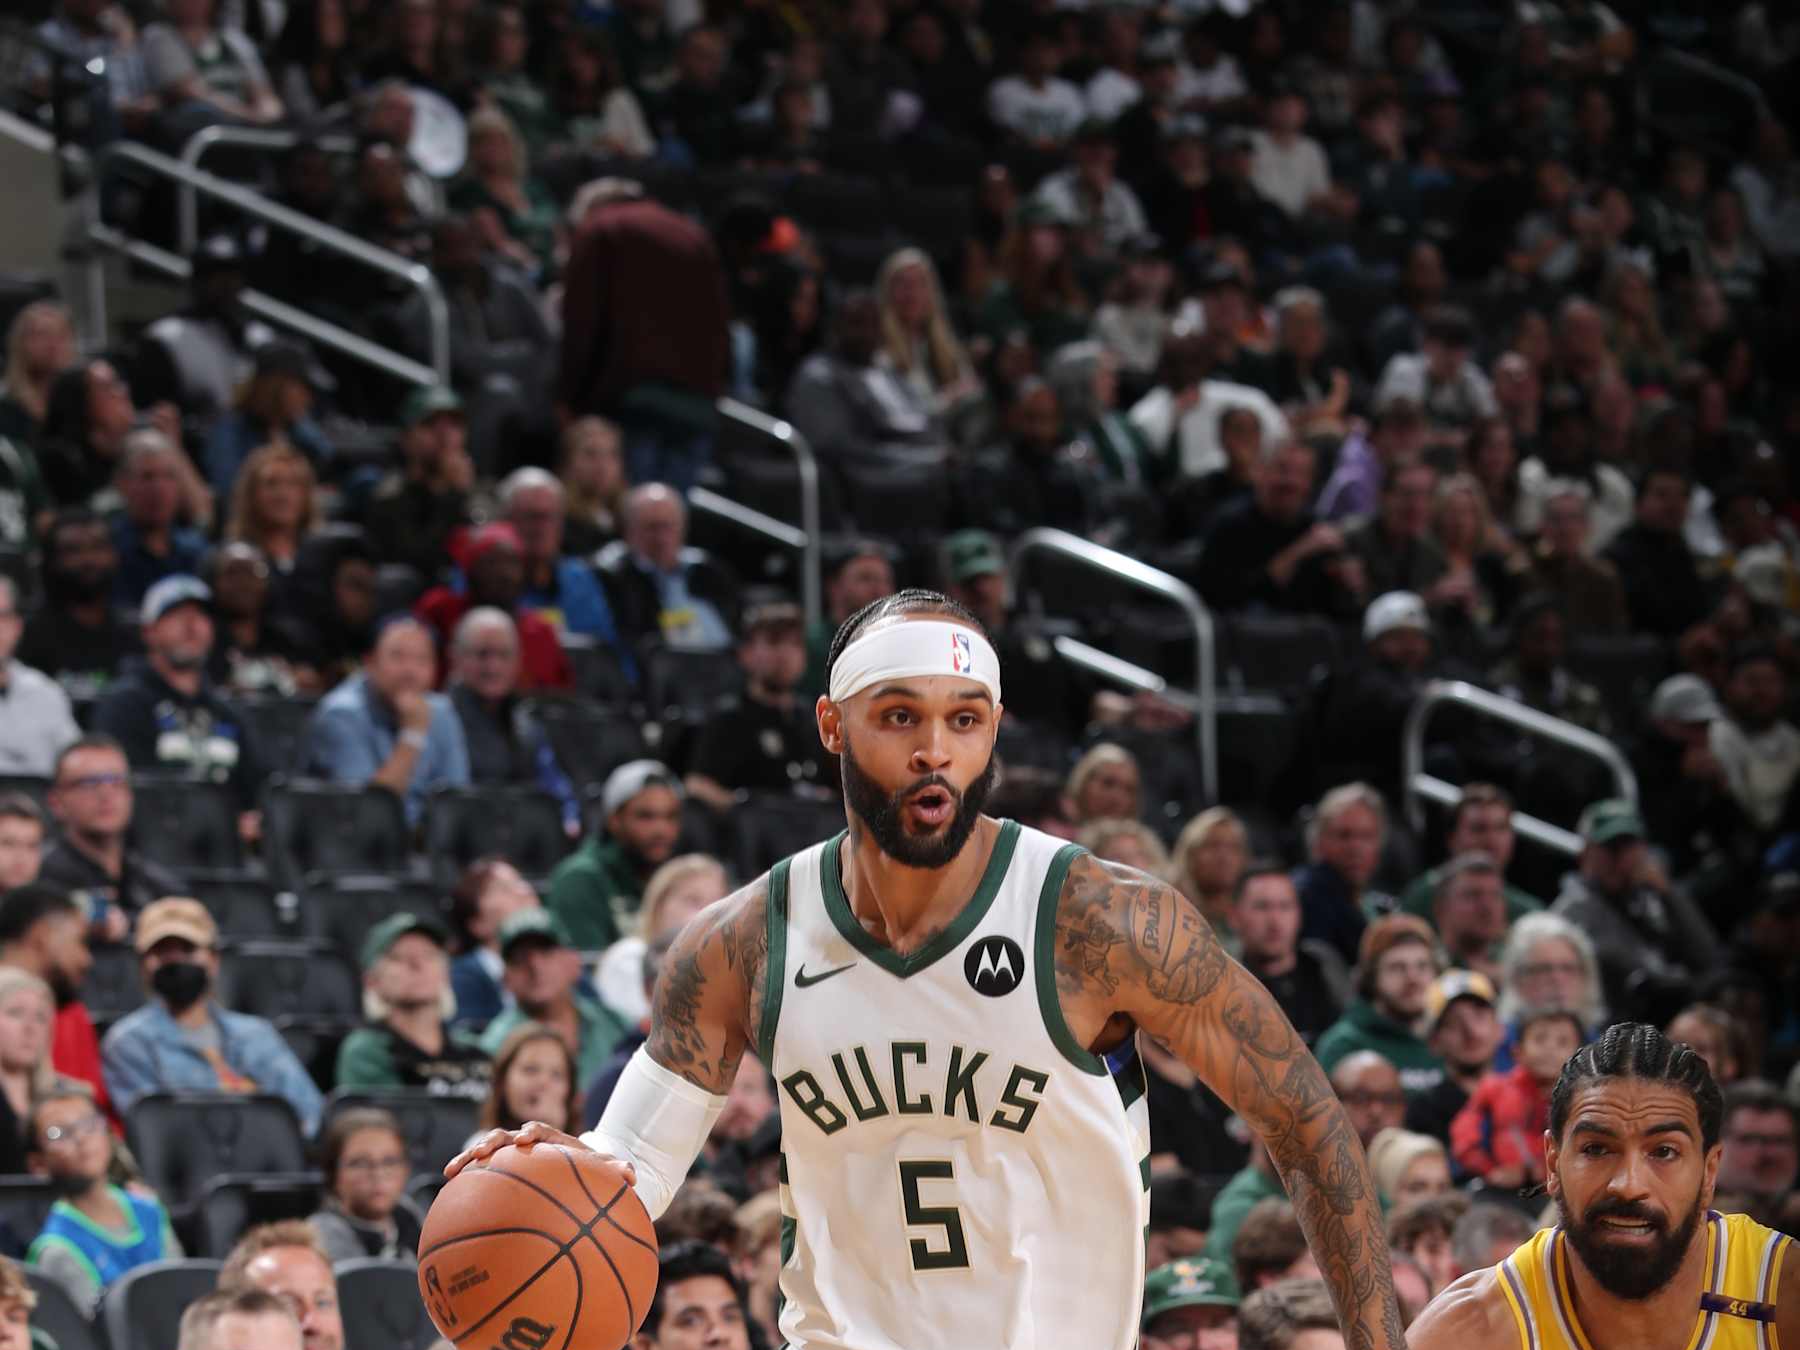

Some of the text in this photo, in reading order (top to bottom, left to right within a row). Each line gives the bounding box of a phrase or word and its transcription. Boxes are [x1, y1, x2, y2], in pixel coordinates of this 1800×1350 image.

[780, 1039, 1053, 1138] BUCKS
[896, 1157, 973, 1273] 5
[1729, 1300, 1748, 1316] 44
